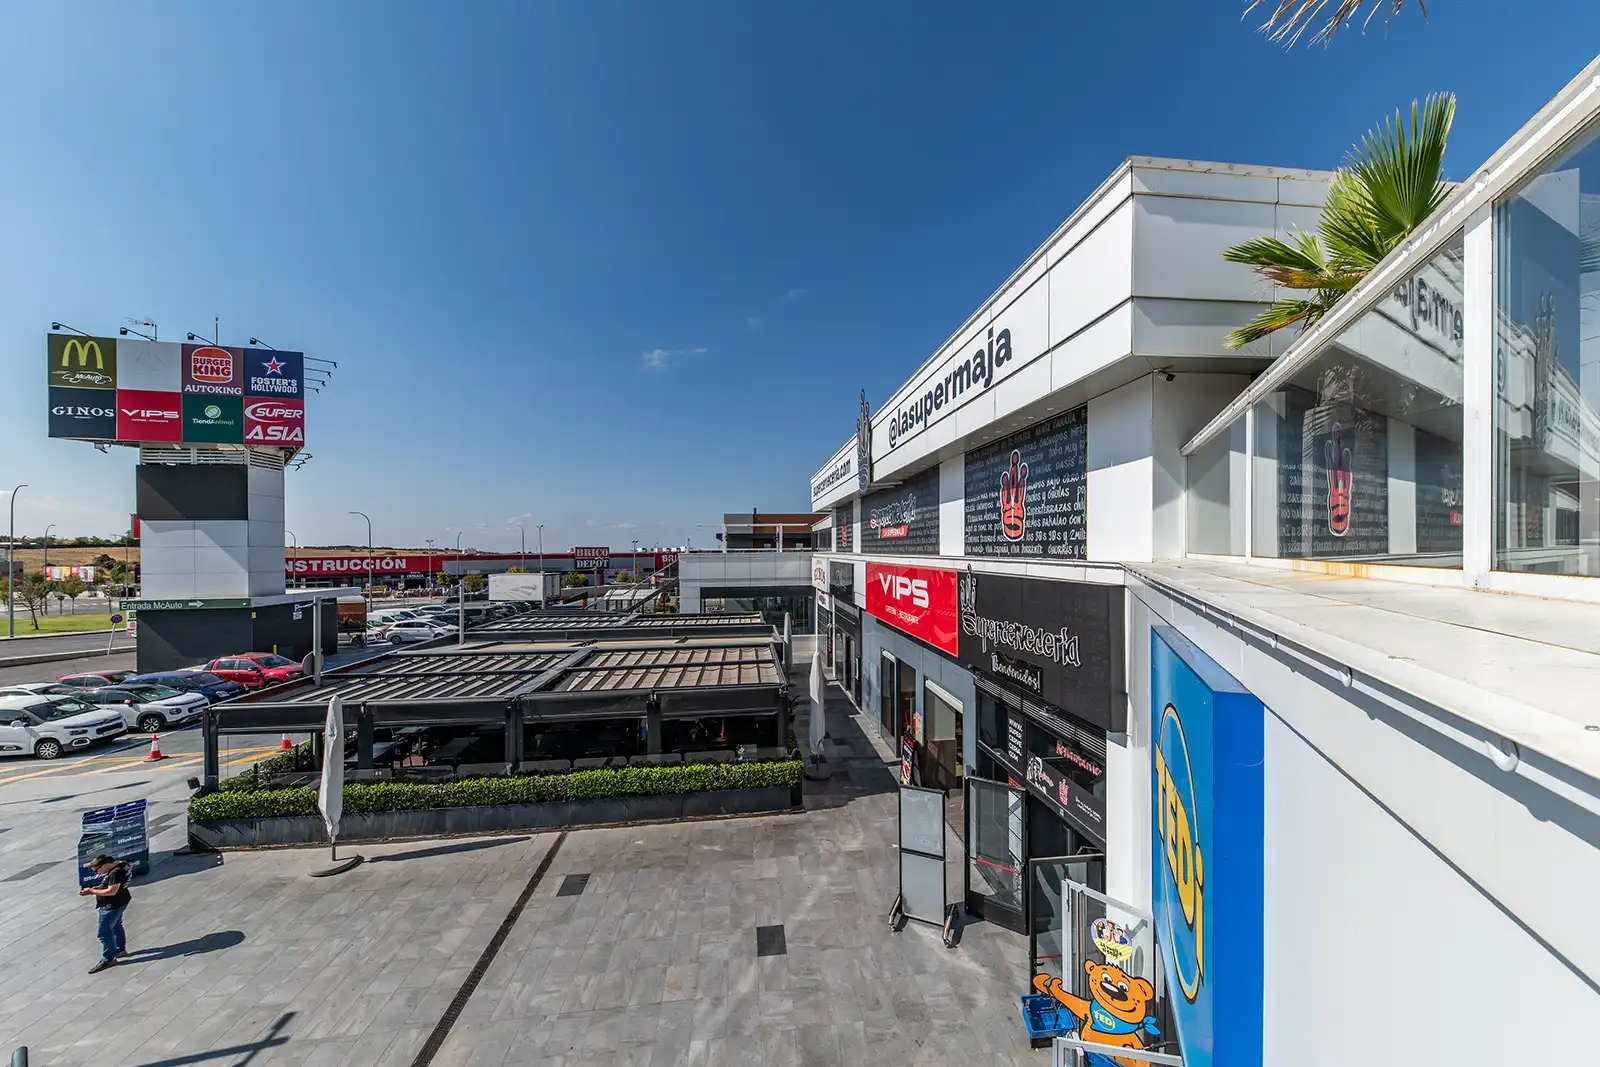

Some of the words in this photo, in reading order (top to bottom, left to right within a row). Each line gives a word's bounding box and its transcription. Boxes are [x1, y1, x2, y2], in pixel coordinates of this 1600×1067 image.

[193, 357, 231, 367] BURGER
[193, 365, 231, 377] KING
[251, 376, 297, 387] FOSTER'S
[184, 384, 242, 395] AUTOKING
[251, 383, 298, 394] HOLLYWOOD
[889, 326, 1012, 449] @lasupermaja
[52, 406, 115, 418] GINOS
[121, 408, 180, 419] VIPS
[255, 407, 303, 419] SUPER
[245, 425, 304, 442] ASIA
[576, 547, 609, 557] BRICO
[878, 572, 930, 609] VIPS
[121, 601, 152, 611] Entrada
[153, 600, 183, 610] McAuto
